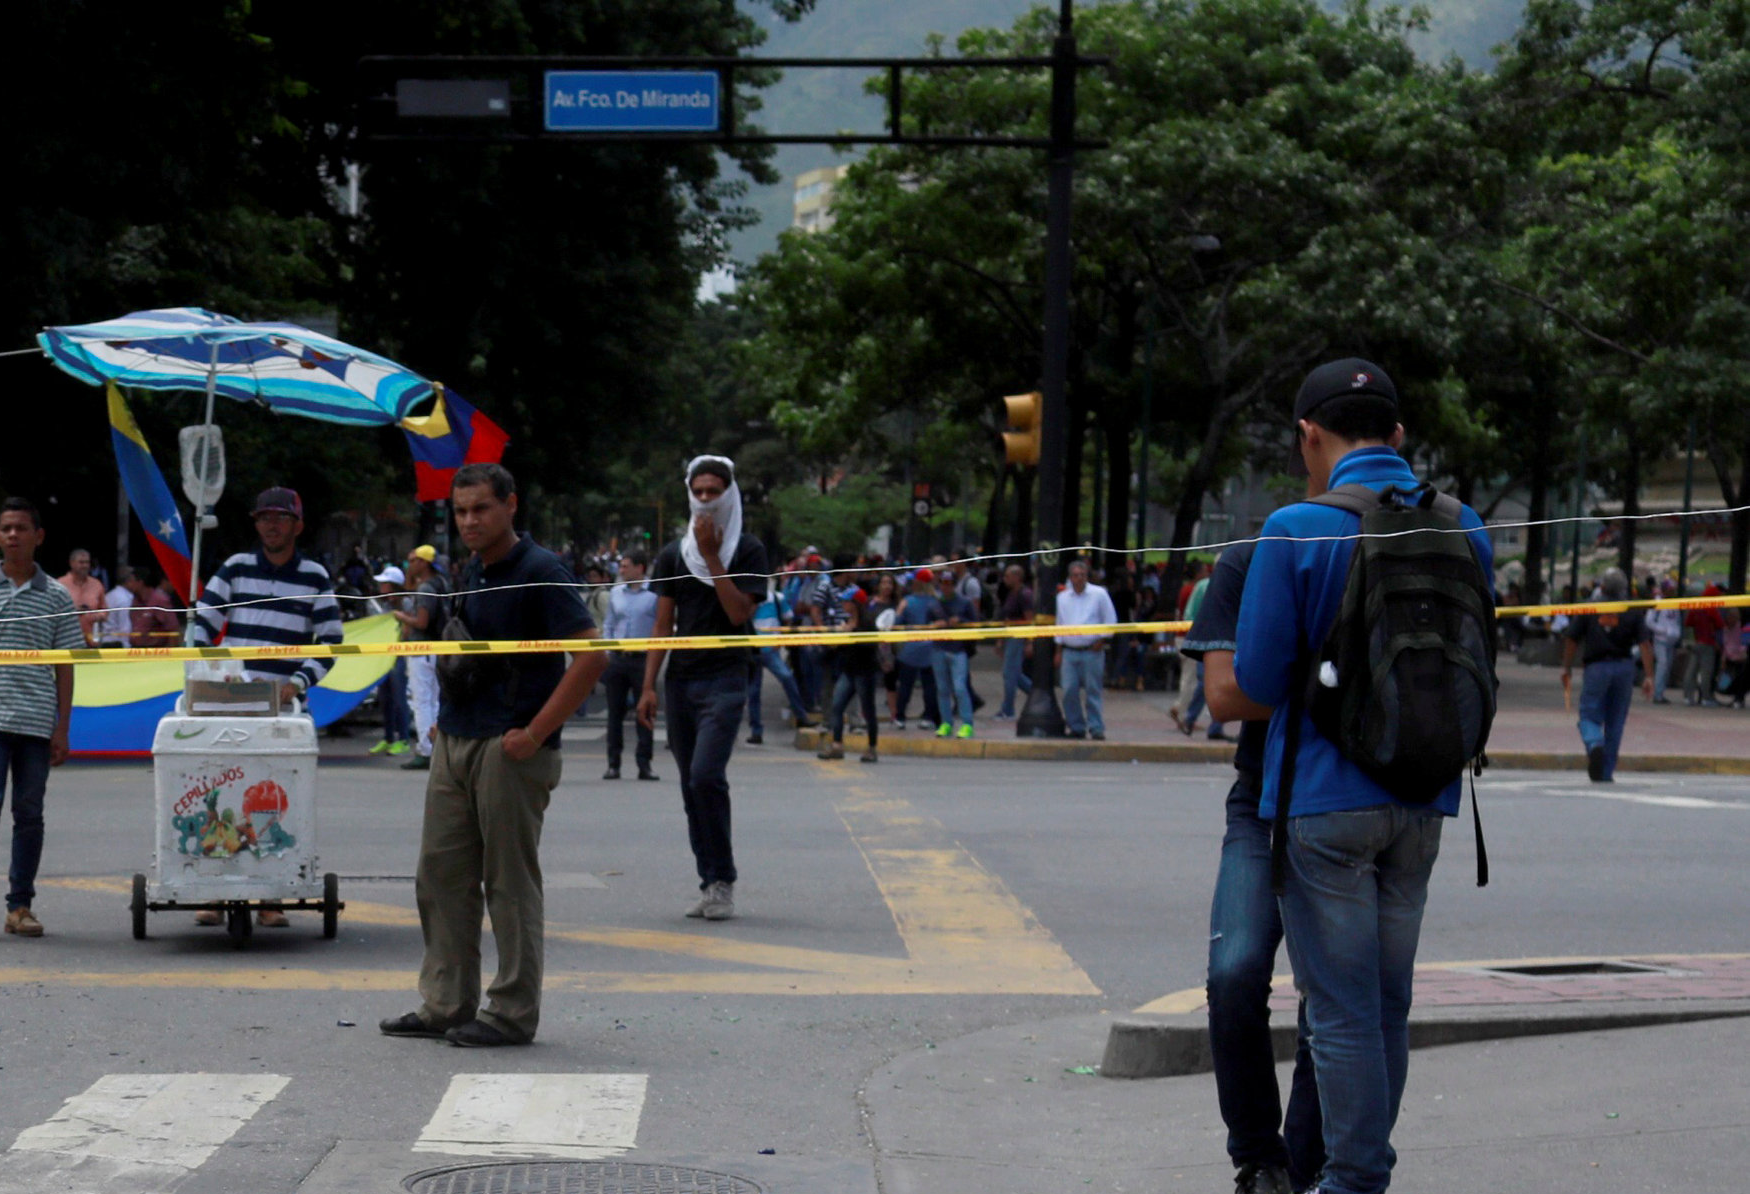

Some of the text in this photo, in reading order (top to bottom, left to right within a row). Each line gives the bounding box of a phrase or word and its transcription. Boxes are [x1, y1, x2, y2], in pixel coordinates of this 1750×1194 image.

[553, 89, 711, 108] Av. Fco. De Miranda
